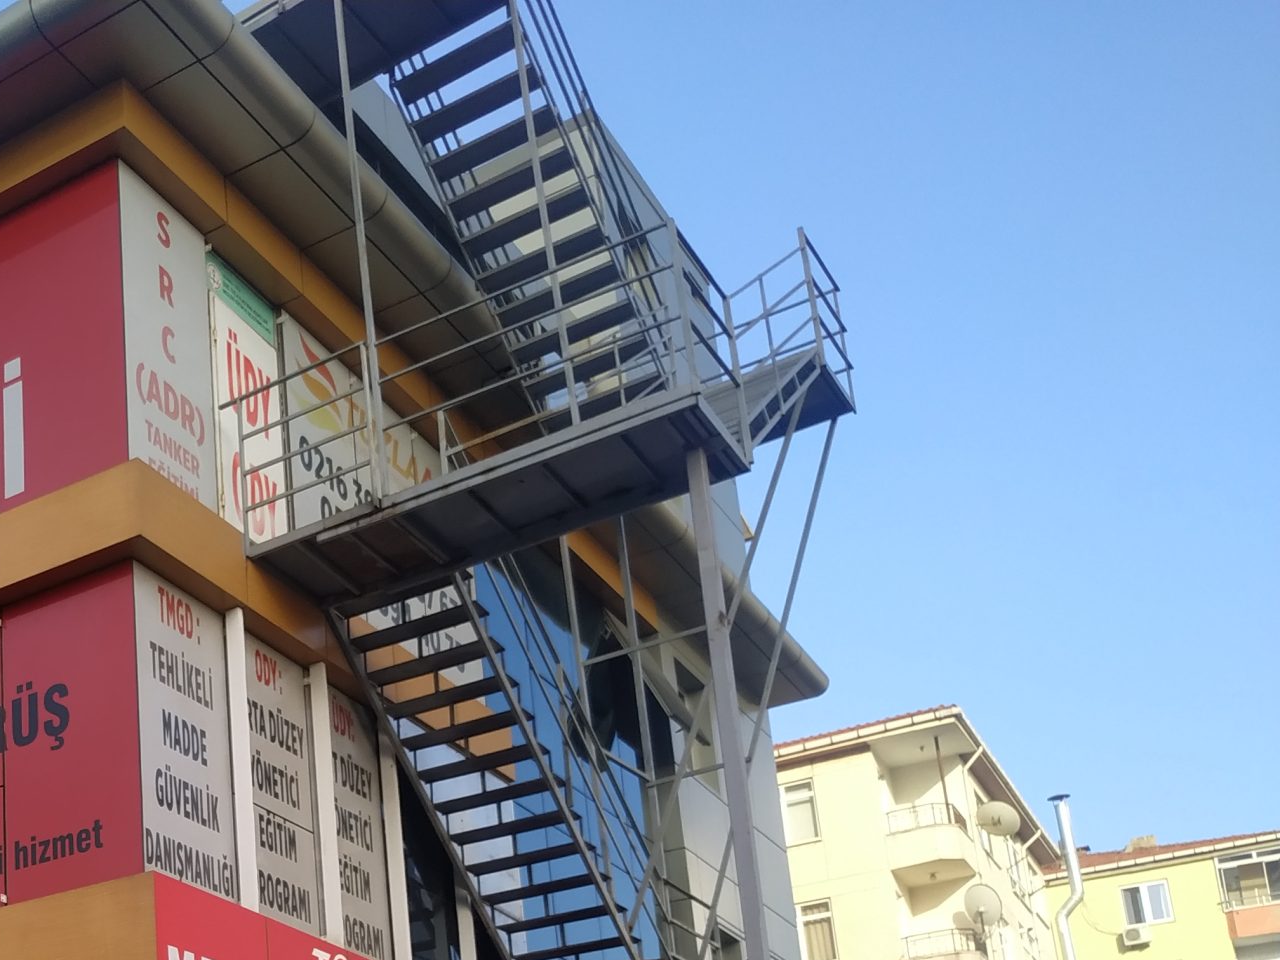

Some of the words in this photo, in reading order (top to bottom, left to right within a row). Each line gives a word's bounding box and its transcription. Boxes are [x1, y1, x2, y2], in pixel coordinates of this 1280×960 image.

[136, 362, 205, 447] (ADR)
[227, 328, 271, 440] ÜDY
[145, 419, 200, 480] TANKER
[150, 640, 214, 711] TEHLİKELİ
[162, 709, 208, 767] MADDE
[247, 697, 267, 739] RTA
[269, 707, 303, 759] DÜZEY
[155, 764, 220, 833] GÜVENLİK
[340, 753, 372, 802] DÜZEY
[14, 819, 104, 871] hizmet
[258, 810, 297, 863] EĞİTİM
[334, 797, 373, 852] ÖNETİCİ
[145, 827, 235, 900] DANIŞMANLIĞI
[258, 869, 311, 924] ROGRAMI
